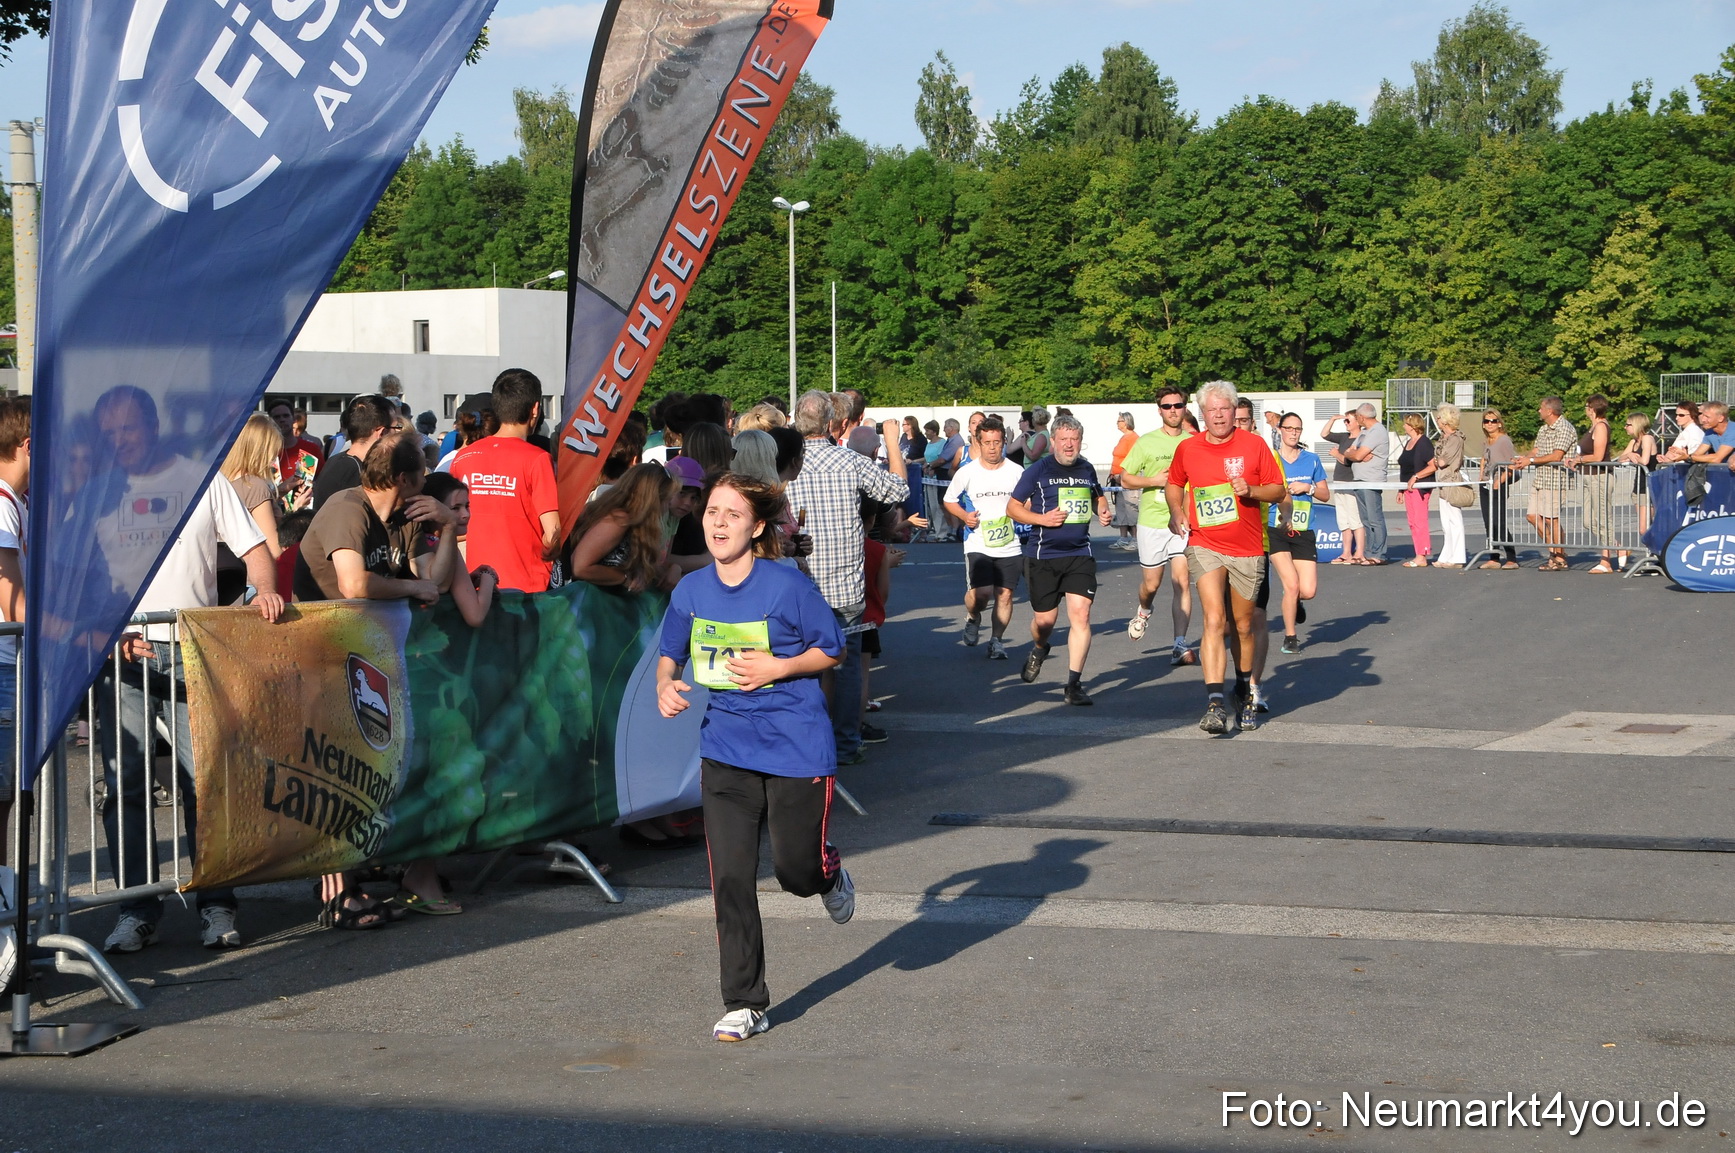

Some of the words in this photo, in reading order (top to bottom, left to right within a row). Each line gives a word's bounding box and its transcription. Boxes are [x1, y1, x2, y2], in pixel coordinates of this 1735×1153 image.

[471, 473, 517, 490] Petry
[1065, 500, 1089, 514] 355
[1196, 497, 1235, 517] 1332
[1682, 503, 1735, 527] Fisch
[1292, 511, 1307, 523] 50
[988, 525, 1010, 541] 222
[1710, 567, 1735, 576] AUT
[700, 646, 756, 670] 71
